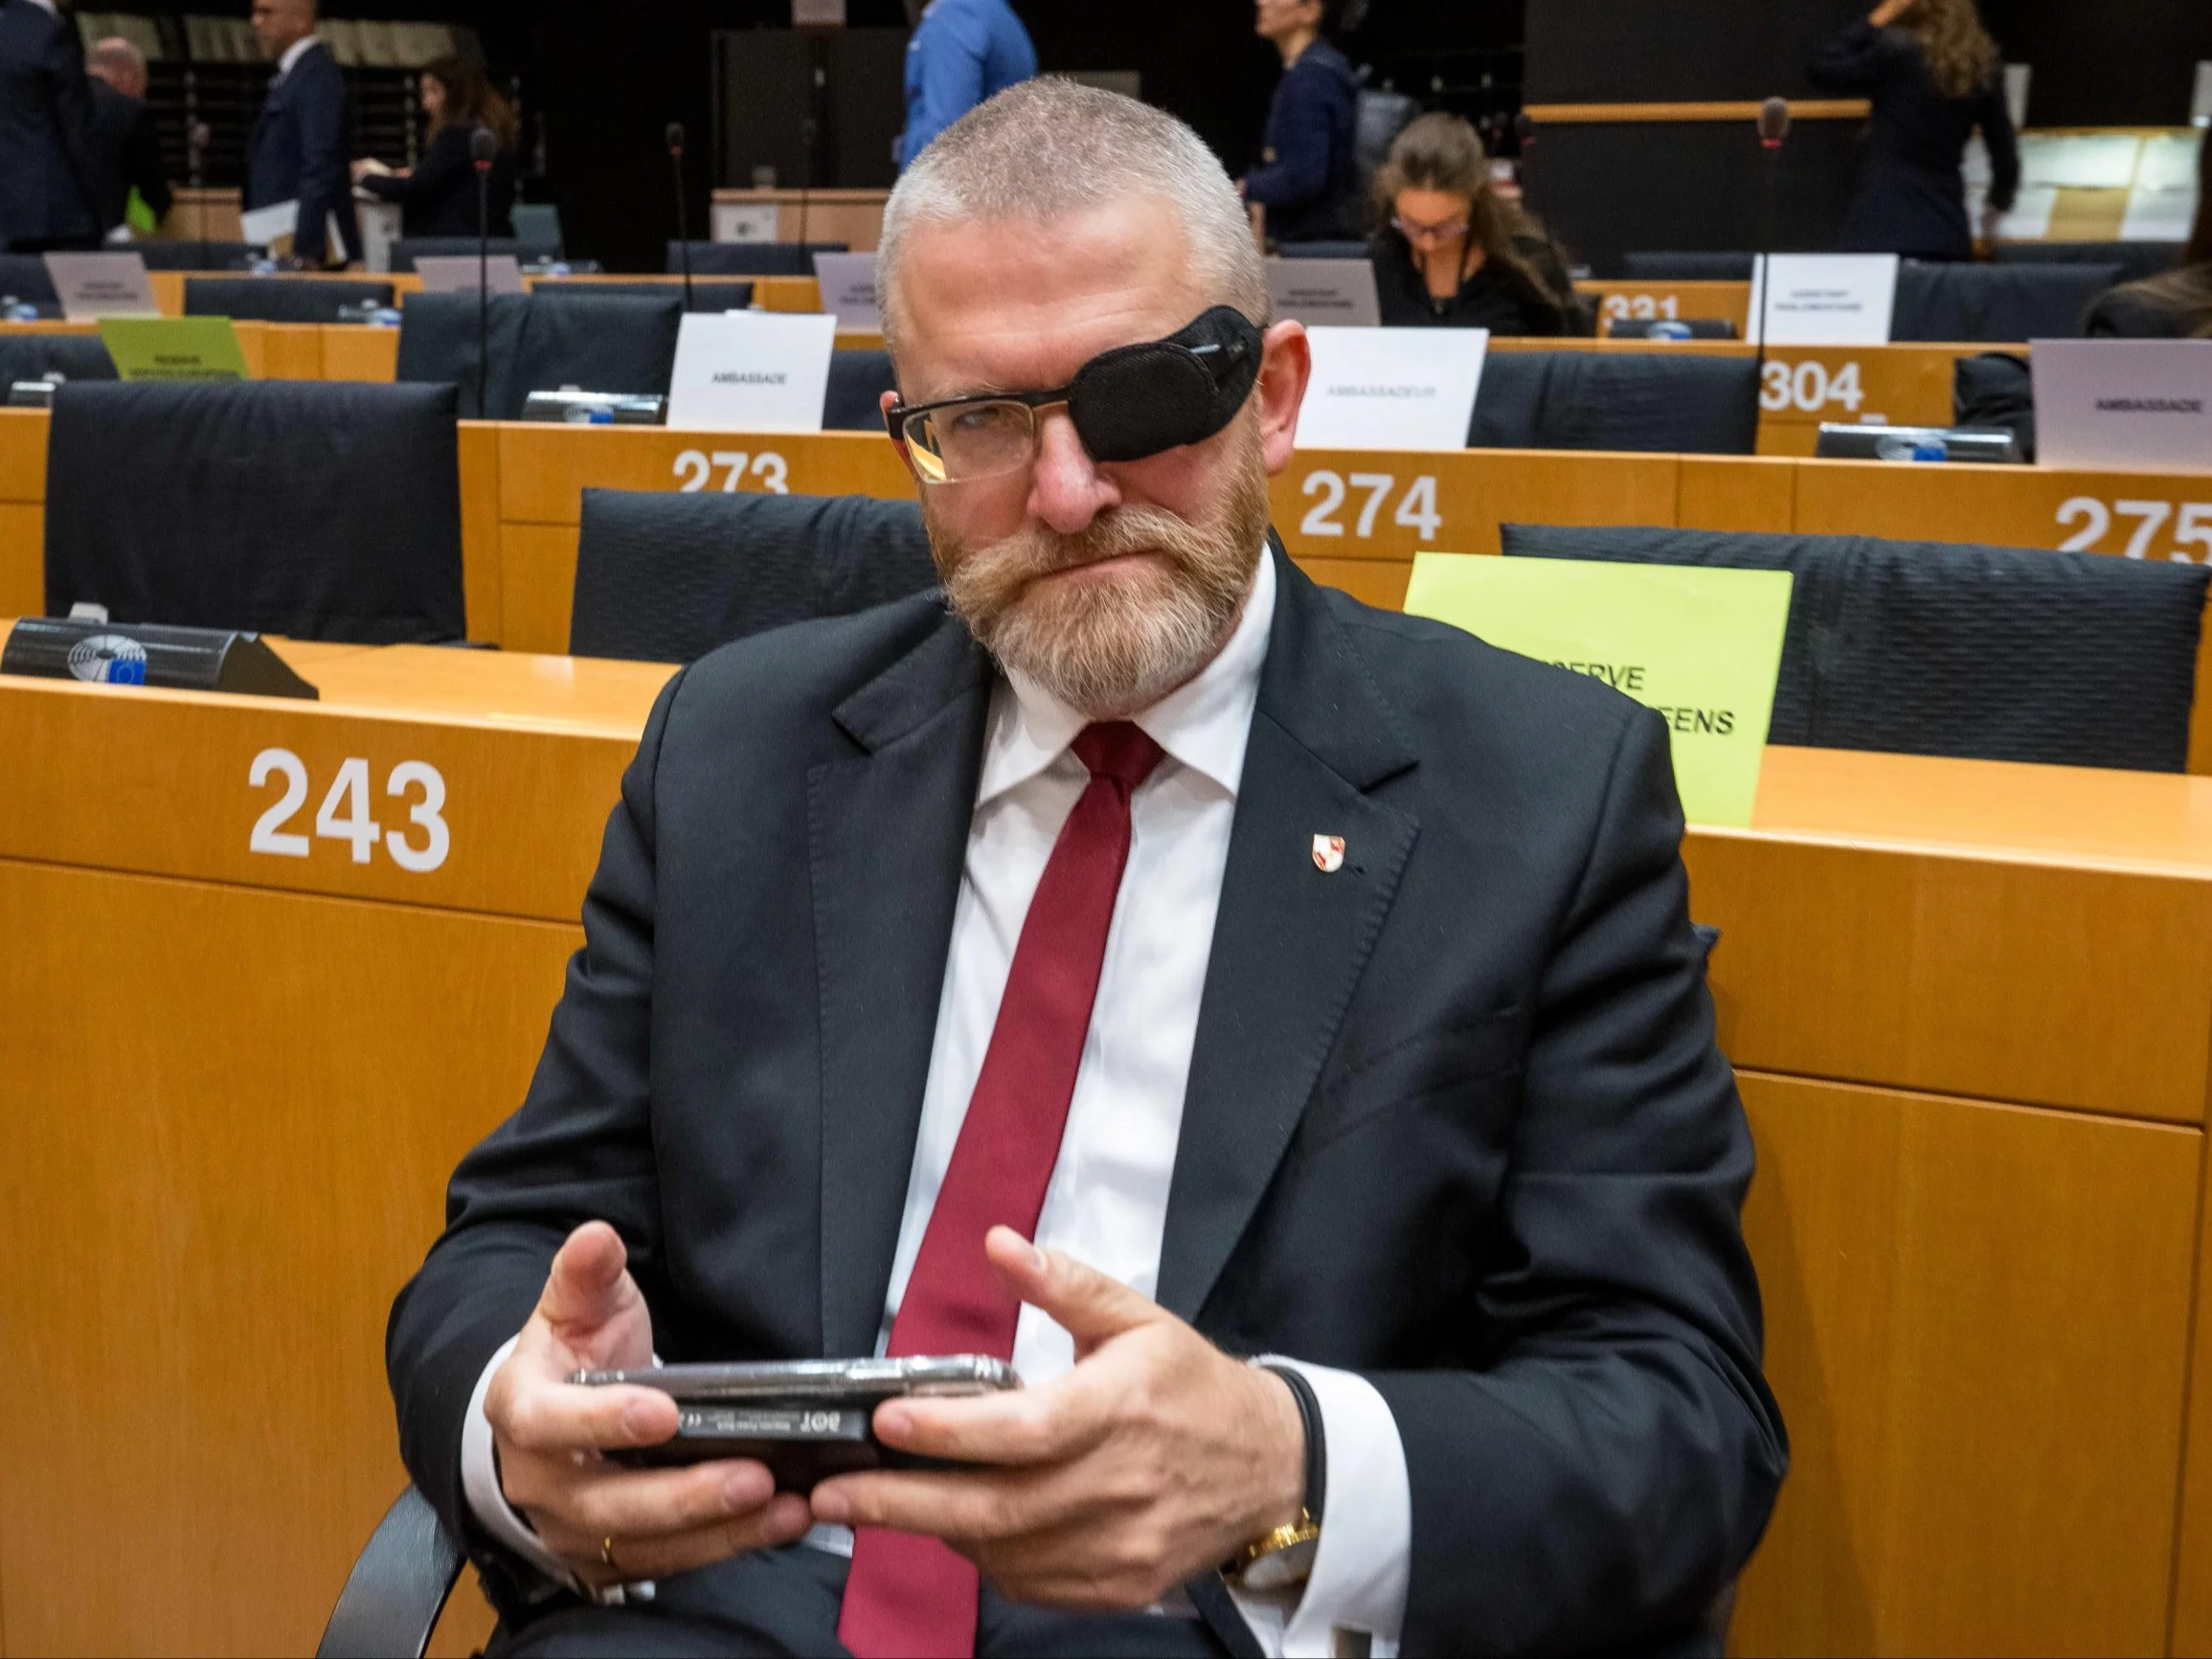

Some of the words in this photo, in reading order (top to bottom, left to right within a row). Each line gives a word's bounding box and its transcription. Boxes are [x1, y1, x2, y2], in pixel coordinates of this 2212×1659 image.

[1759, 360, 1864, 412] 304
[673, 449, 790, 495] 273
[1300, 470, 1442, 541] 274
[2056, 496, 2212, 567] 275
[248, 748, 450, 873] 243
